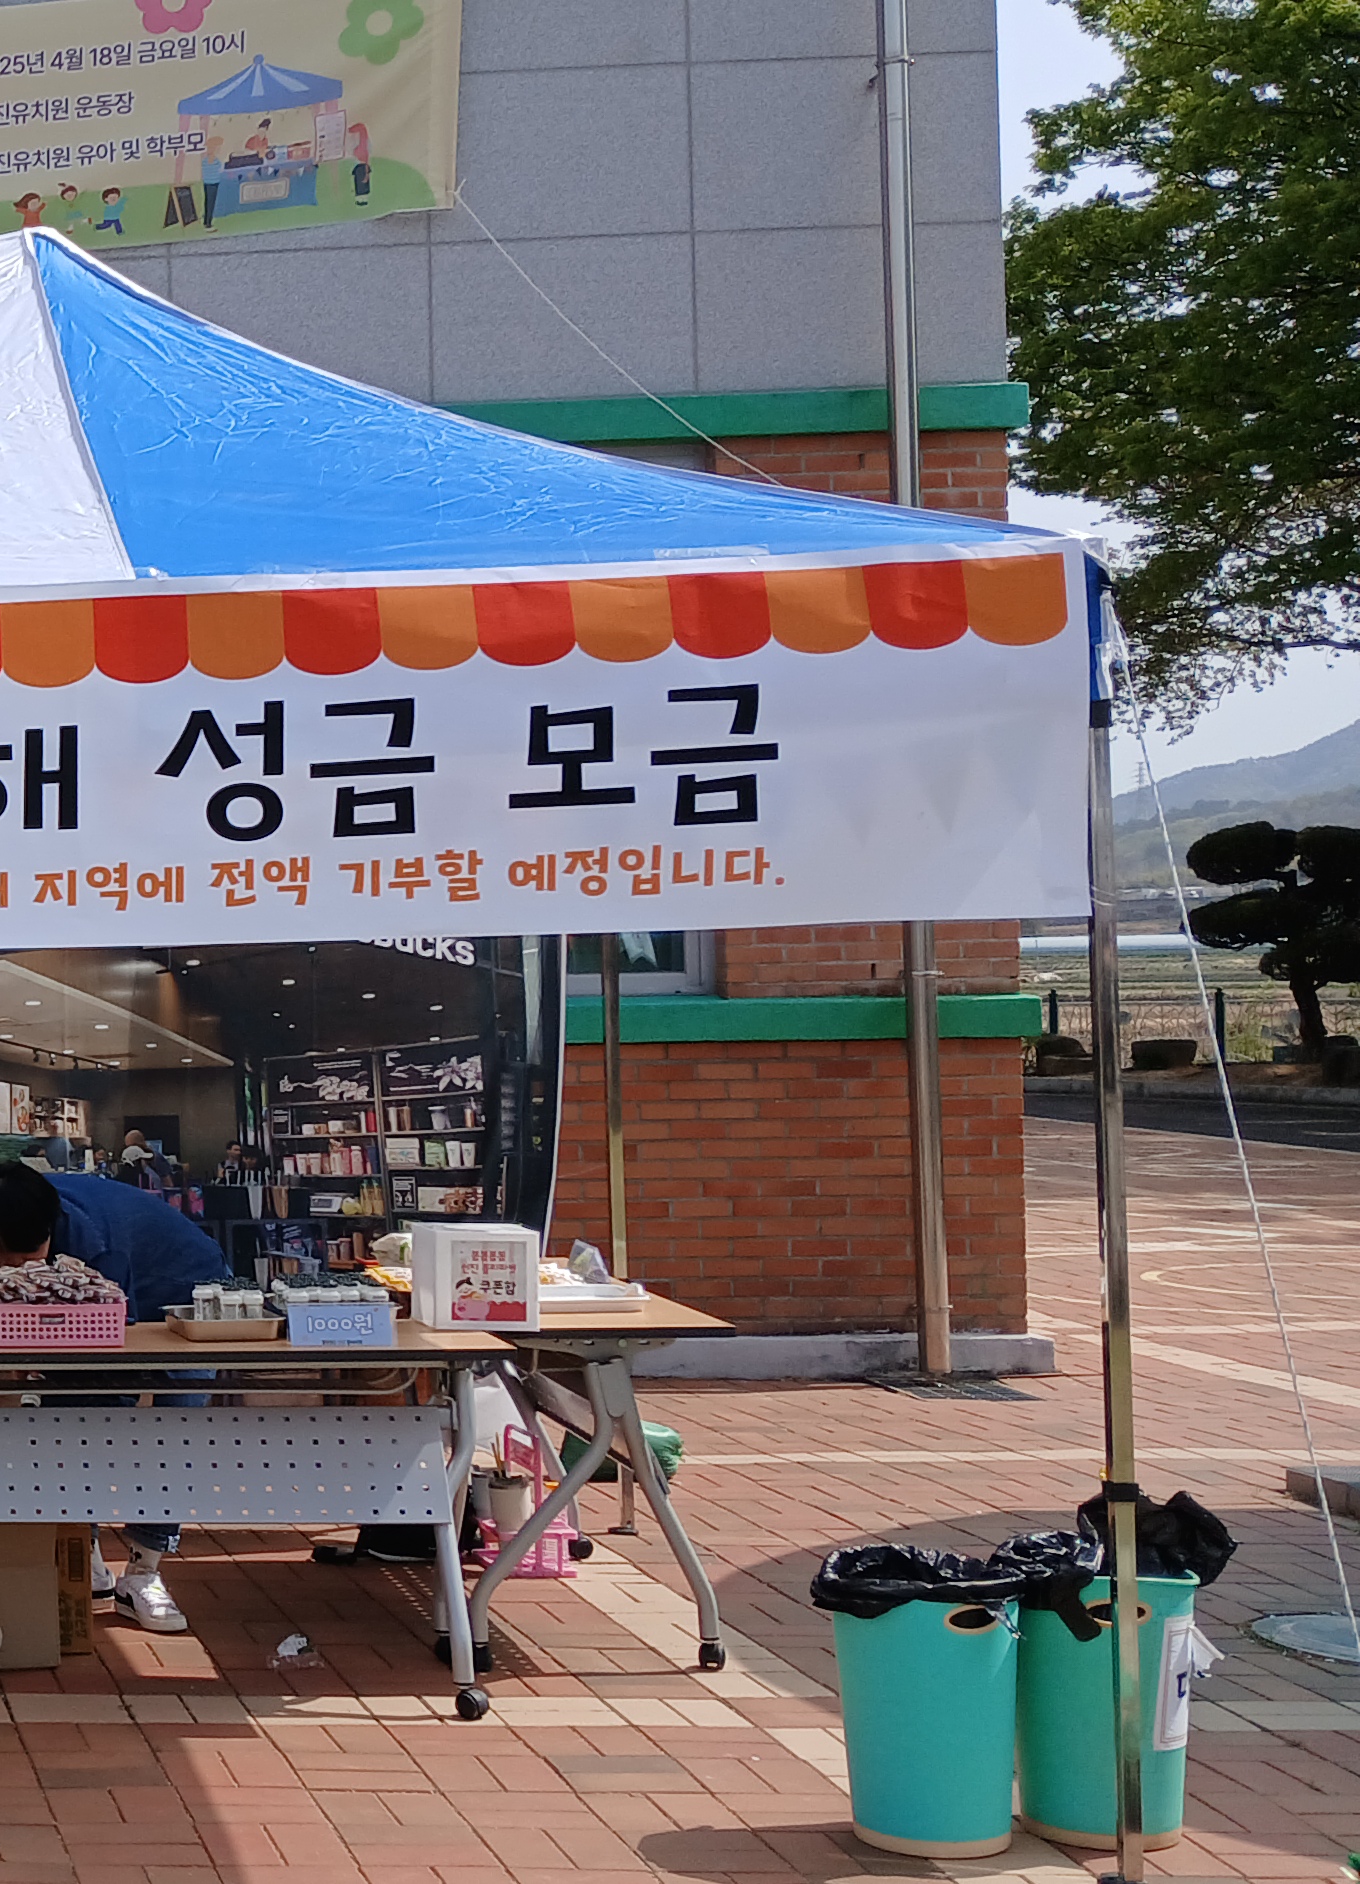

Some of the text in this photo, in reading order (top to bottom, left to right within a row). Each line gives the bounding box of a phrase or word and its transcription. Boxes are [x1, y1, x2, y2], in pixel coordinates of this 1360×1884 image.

[50, 48, 83, 70] 4월
[88, 42, 133, 68] 18일
[137, 35, 196, 64] 금요일
[202, 31, 245, 57] 10시
[74, 91, 134, 118] 운동장
[76, 138, 117, 165] 유아
[121, 138, 140, 162] 및
[145, 131, 205, 158] 학부모
[153, 696, 437, 842] 성금
[508, 683, 780, 827] 모금
[32, 861, 184, 912] 지역에
[209, 855, 312, 908] 전액
[338, 849, 484, 902] 기부할
[507, 845, 786, 897] 예정입니다.
[479, 1280, 517, 1296] 쿠폰함
[307, 1313, 374, 1335] 1000원
